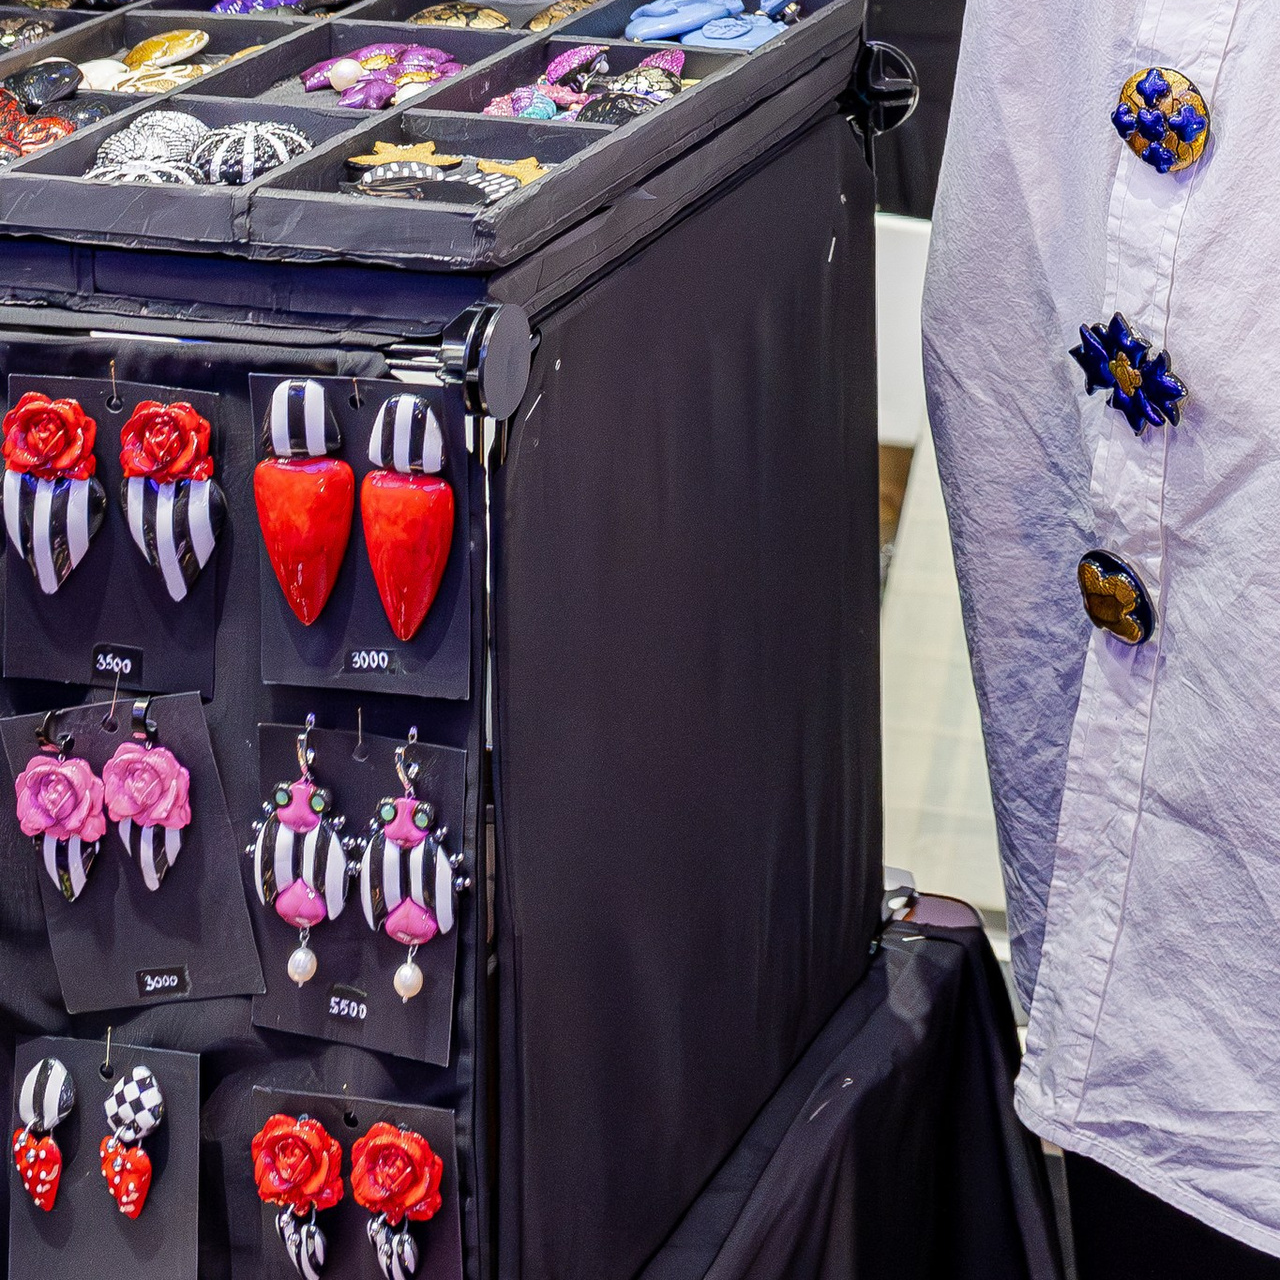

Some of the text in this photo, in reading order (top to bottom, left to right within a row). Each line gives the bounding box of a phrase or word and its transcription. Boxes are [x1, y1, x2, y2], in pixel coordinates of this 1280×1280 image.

[95, 652, 132, 674] 3500
[351, 650, 389, 669] 3000
[144, 974, 178, 992] 3000
[328, 996, 368, 1020] 5500
